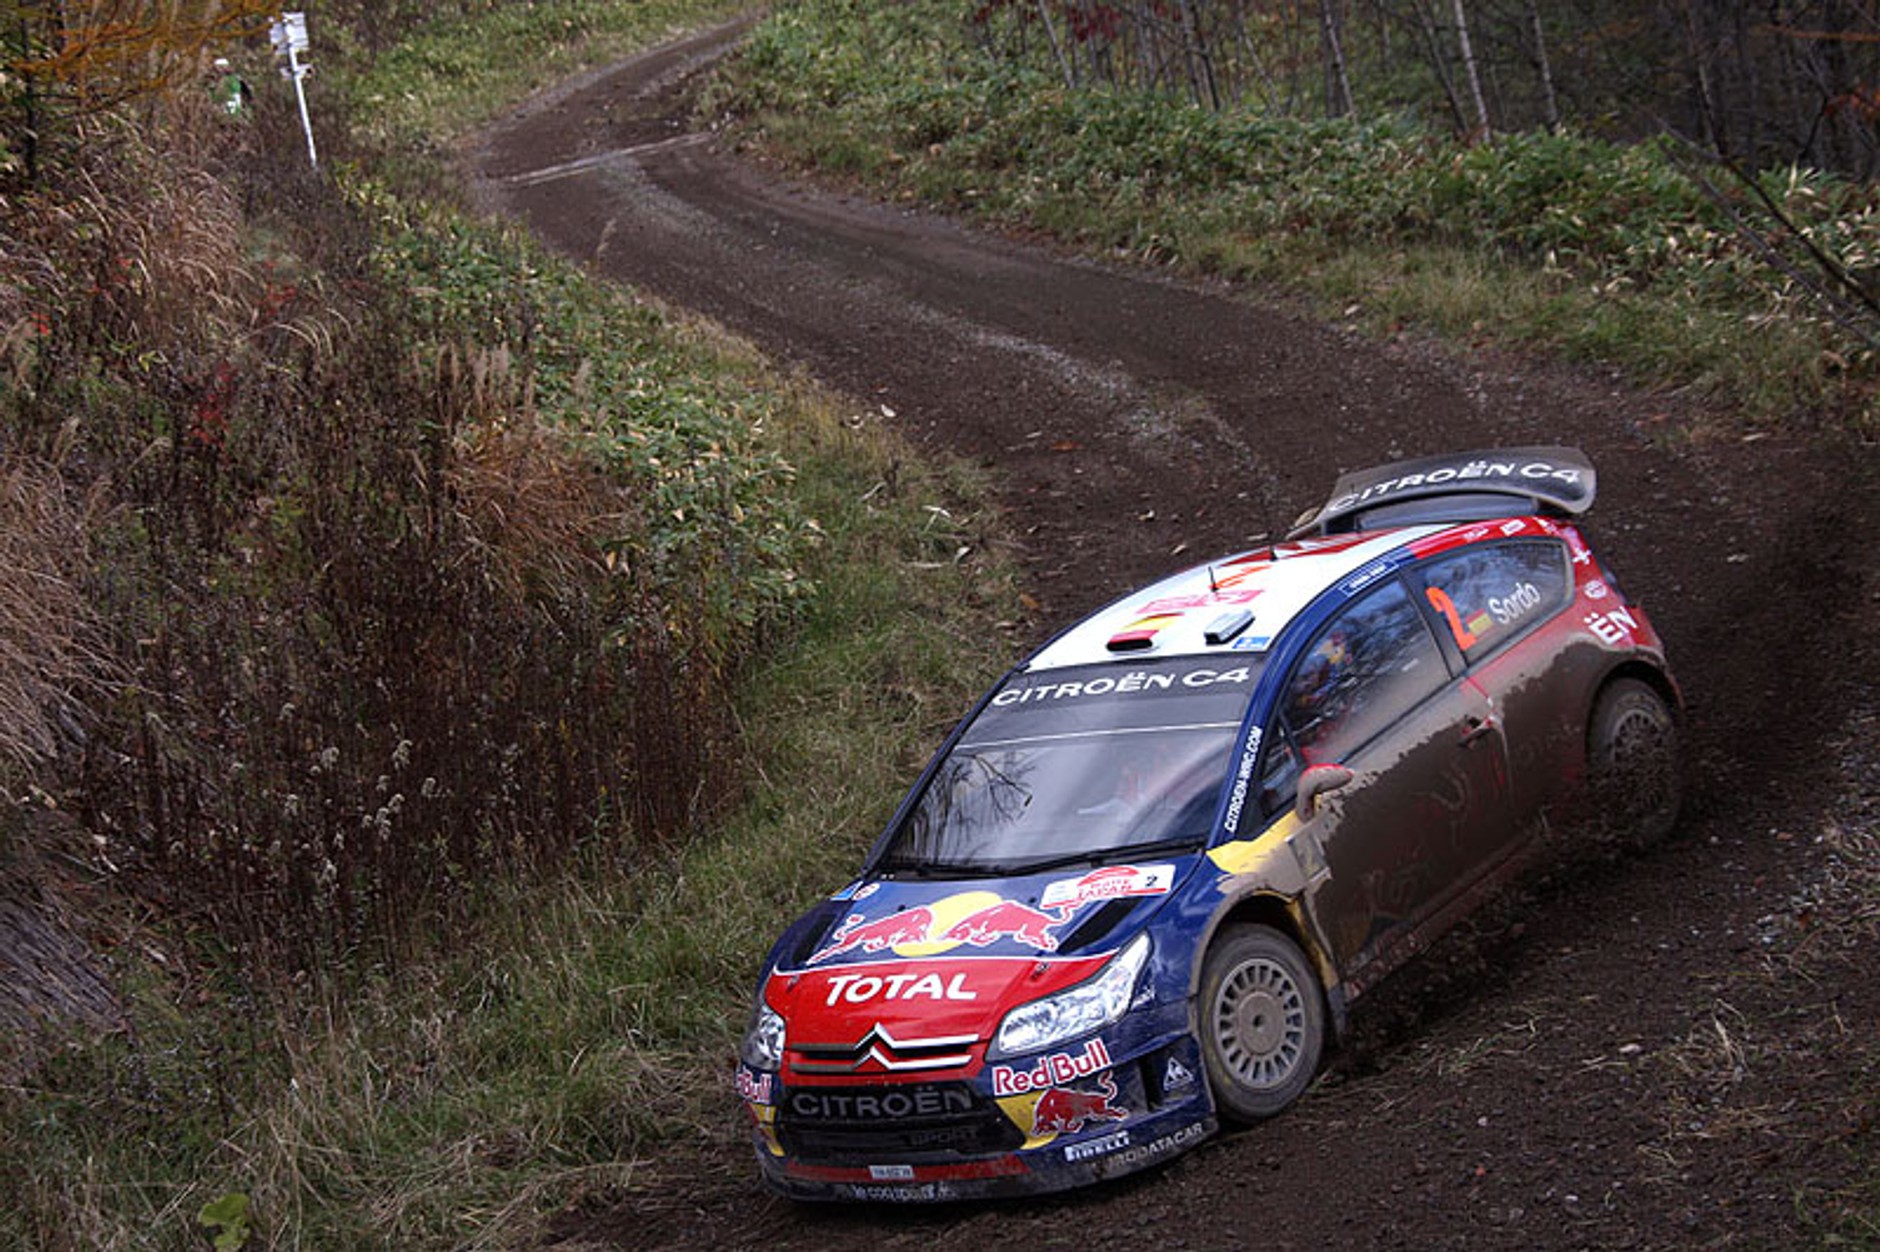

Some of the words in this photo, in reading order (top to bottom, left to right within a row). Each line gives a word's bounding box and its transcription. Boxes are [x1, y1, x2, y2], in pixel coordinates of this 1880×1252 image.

[1330, 460, 1515, 511] CITROËN
[1520, 463, 1581, 484] C4
[1425, 586, 1477, 650] 2
[1488, 582, 1541, 624] Sordo
[991, 671, 1176, 706] CITROËN
[1182, 667, 1250, 687] C4
[1145, 874, 1158, 887] 2
[826, 973, 978, 1007] TOTAL
[993, 1057, 1051, 1096] Red
[1051, 1038, 1112, 1083] Bull
[791, 1084, 973, 1118] CITROËN
